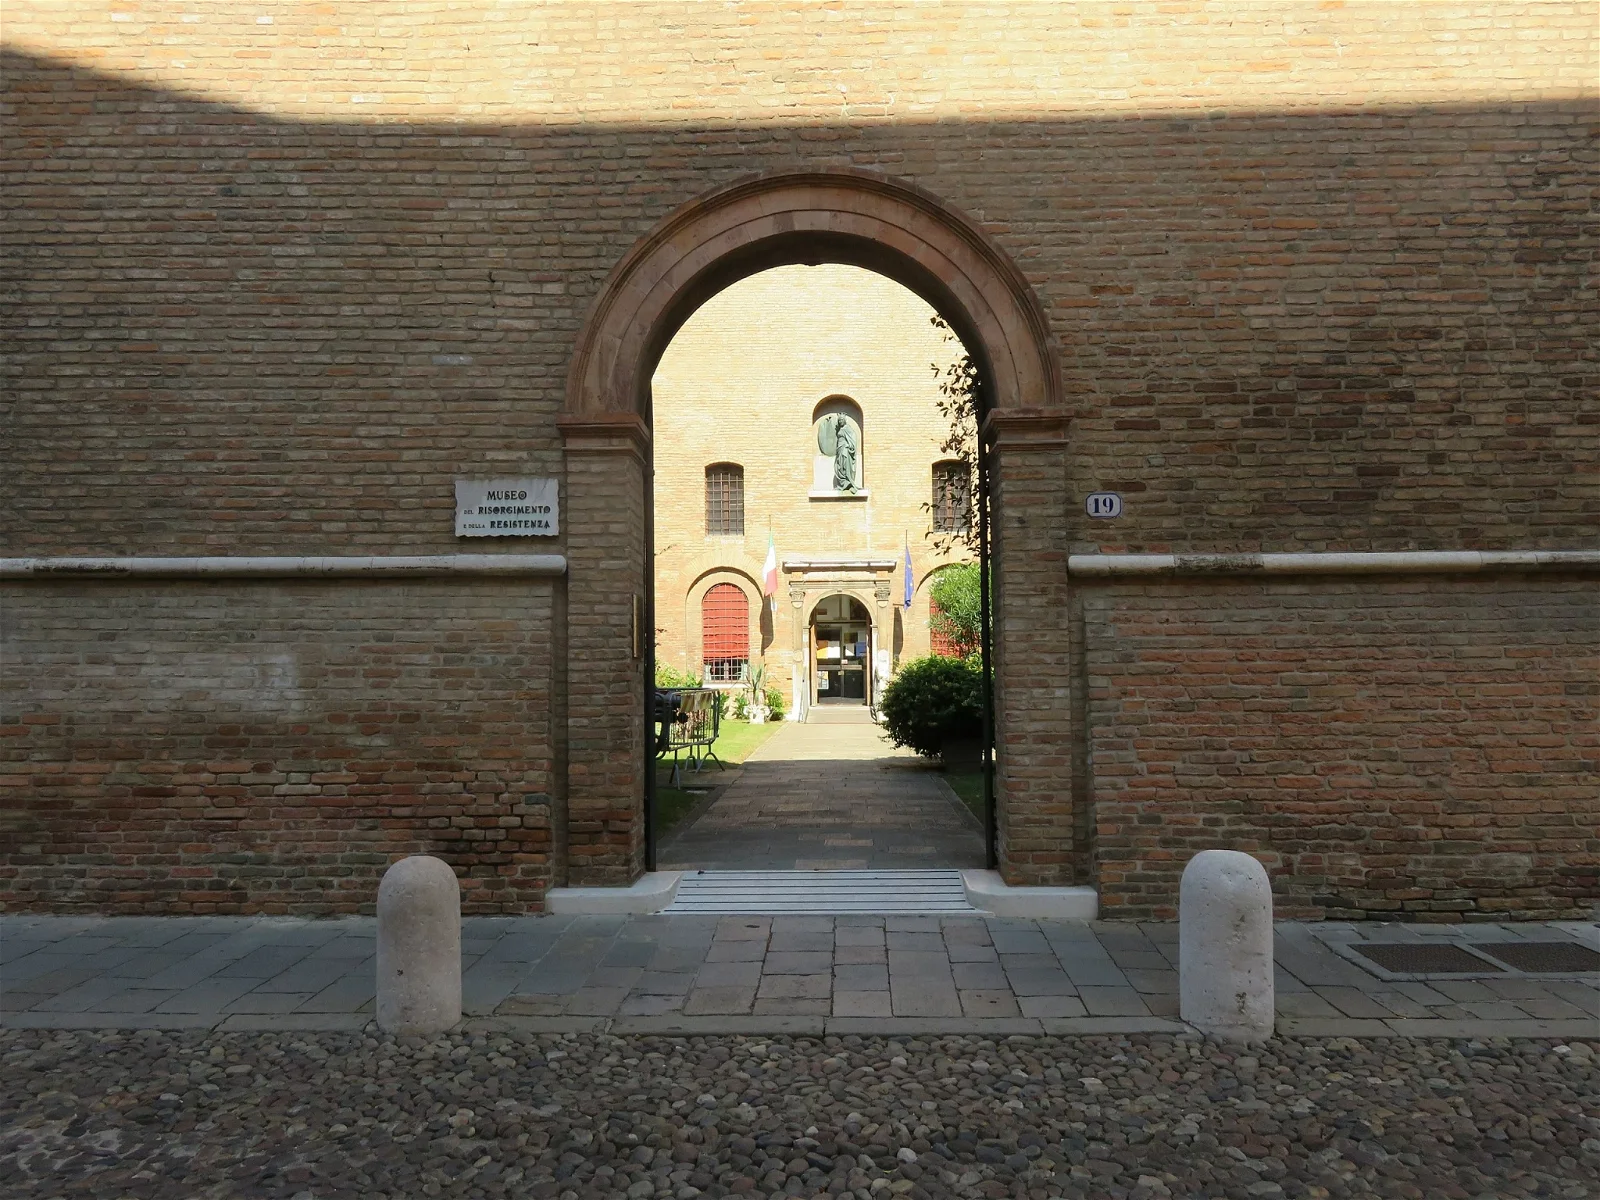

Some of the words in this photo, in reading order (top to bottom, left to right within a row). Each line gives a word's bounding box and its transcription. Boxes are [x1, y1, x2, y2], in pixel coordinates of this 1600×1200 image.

[487, 490, 527, 500] MUSEO
[478, 505, 551, 515] RISORGIMENTO
[1093, 497, 1114, 514] 19
[490, 520, 551, 529] RESISTENZA
